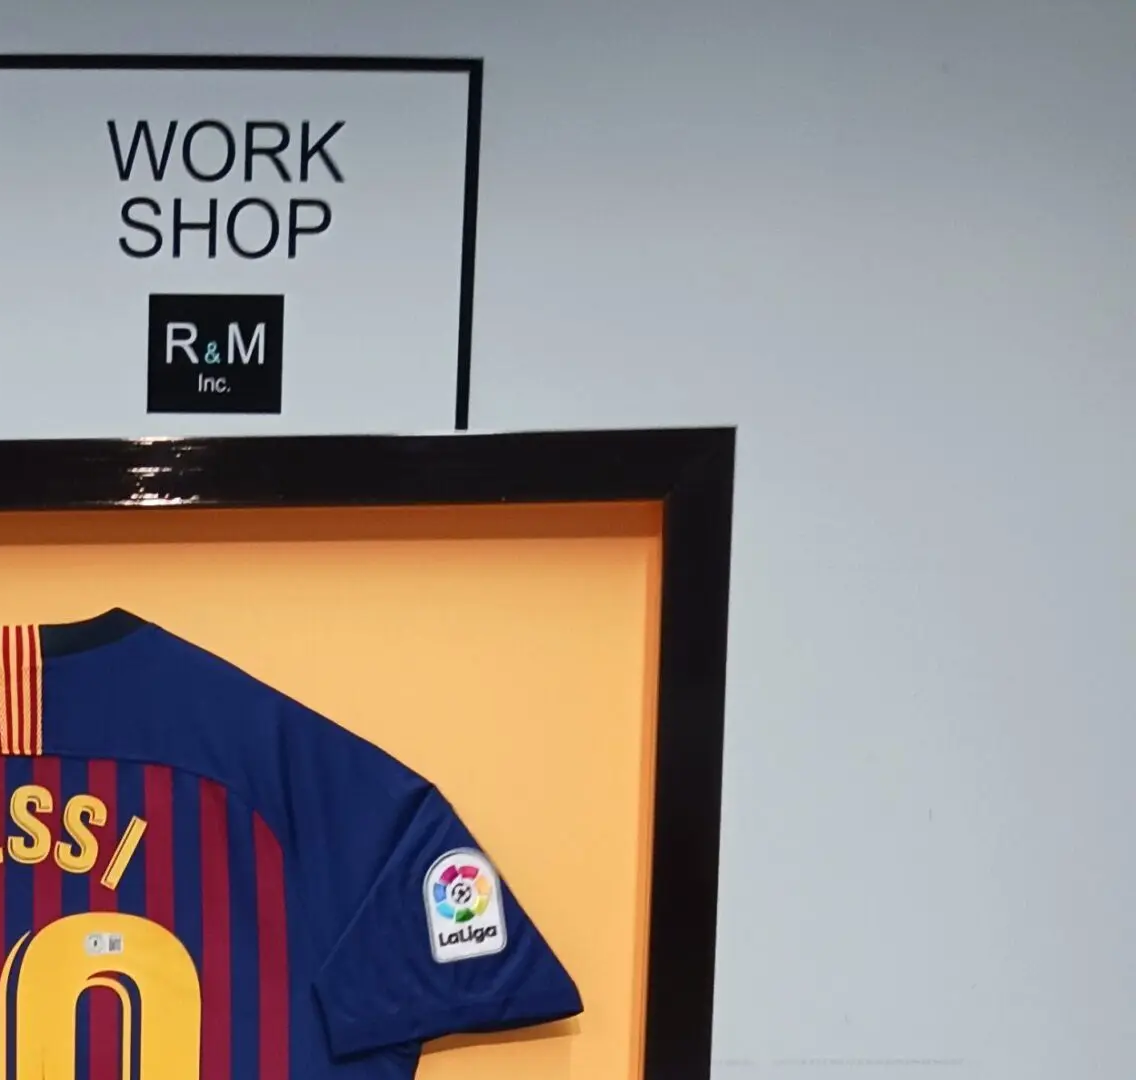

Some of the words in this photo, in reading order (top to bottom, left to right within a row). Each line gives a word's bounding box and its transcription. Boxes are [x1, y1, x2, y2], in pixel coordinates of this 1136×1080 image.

[106, 119, 346, 183] WORK
[118, 196, 333, 259] SHOP
[197, 372, 232, 393] Inc.
[438, 924, 498, 947] LaLiga
